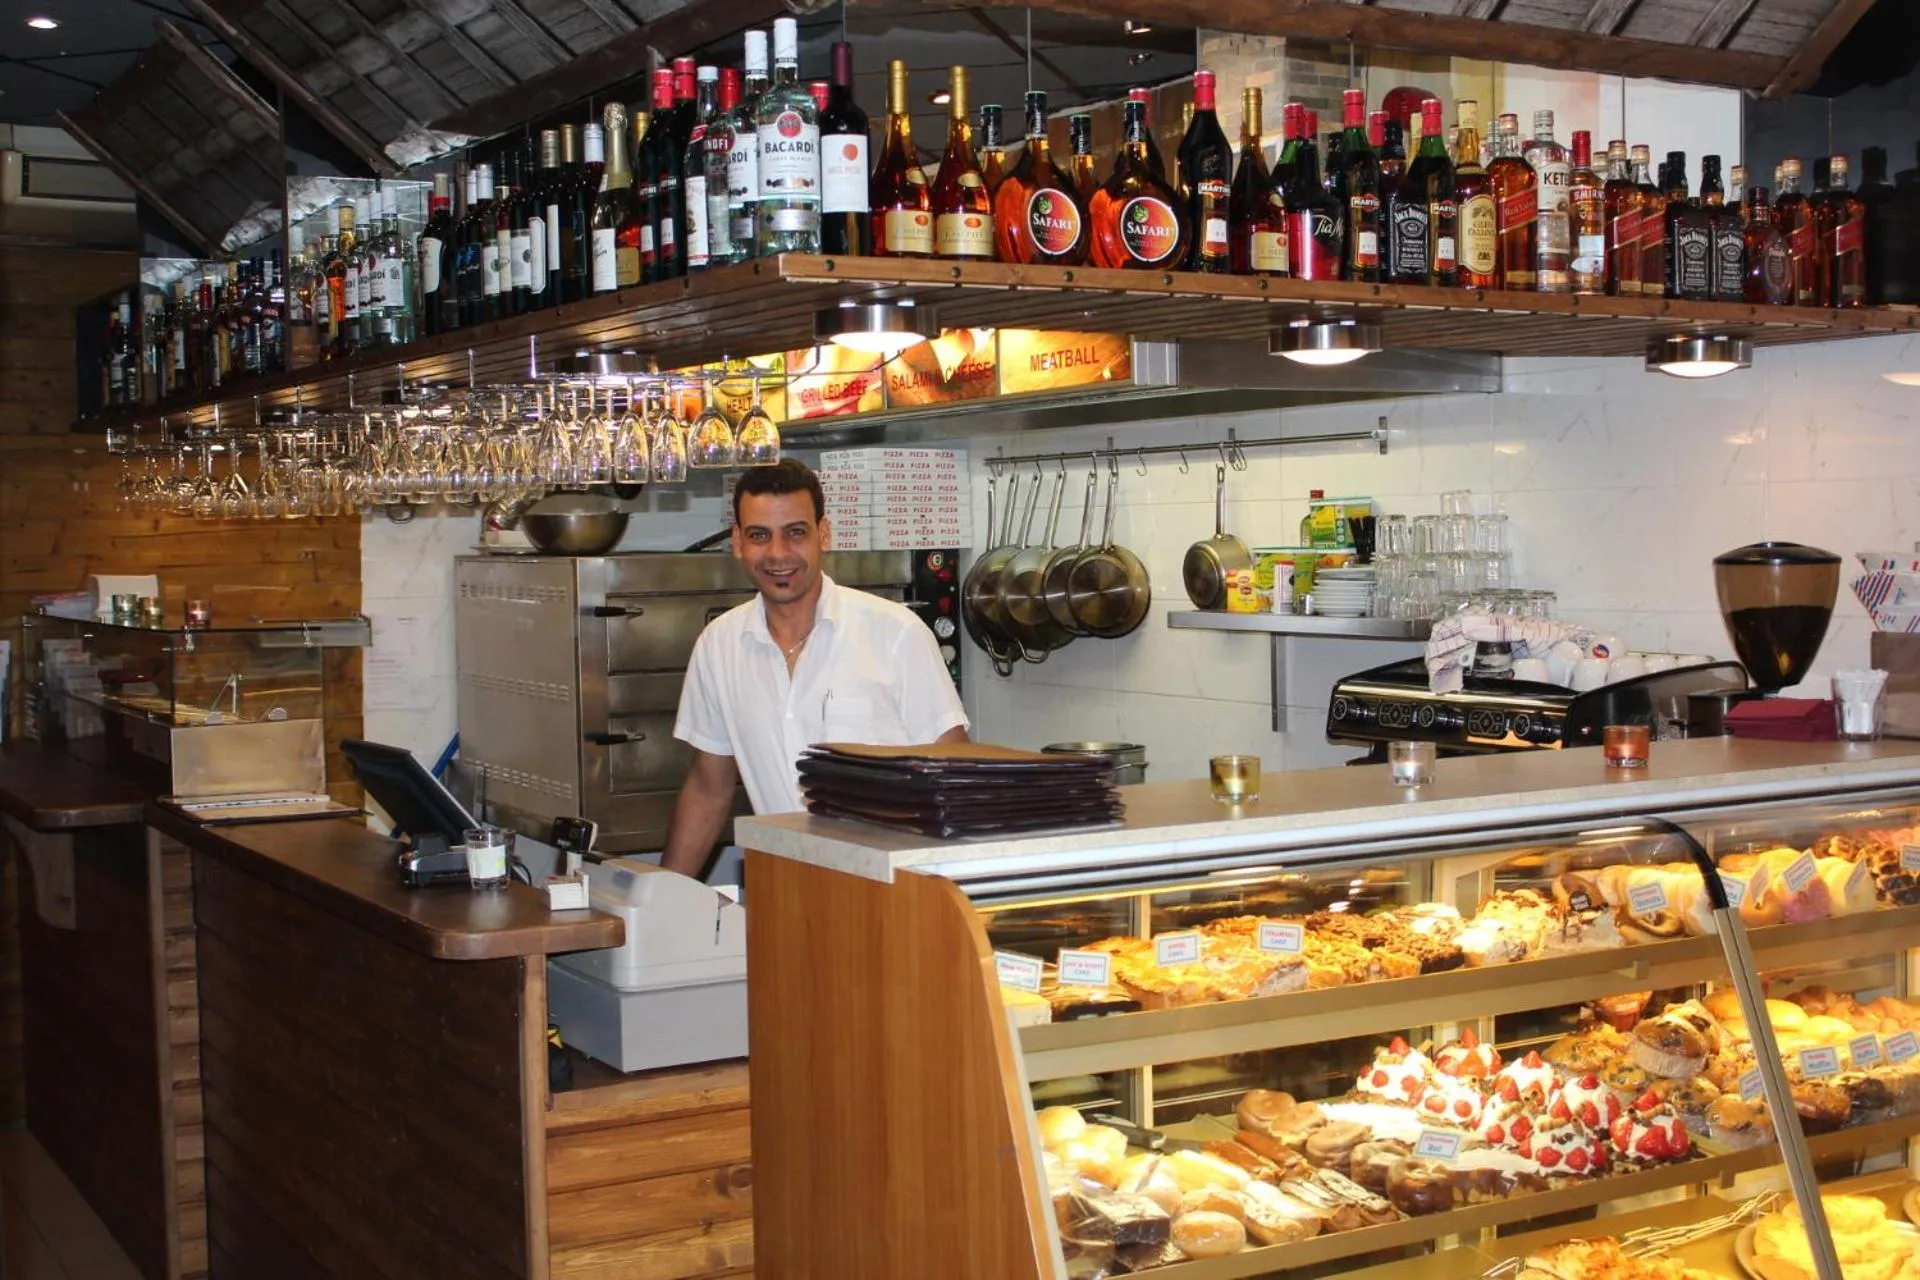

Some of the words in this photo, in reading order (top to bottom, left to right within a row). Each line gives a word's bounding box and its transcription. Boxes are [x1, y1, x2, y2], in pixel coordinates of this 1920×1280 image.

[1032, 213, 1073, 229] SAFARI
[1126, 221, 1171, 237] SAFARI
[1030, 346, 1100, 372] MEATBALL
